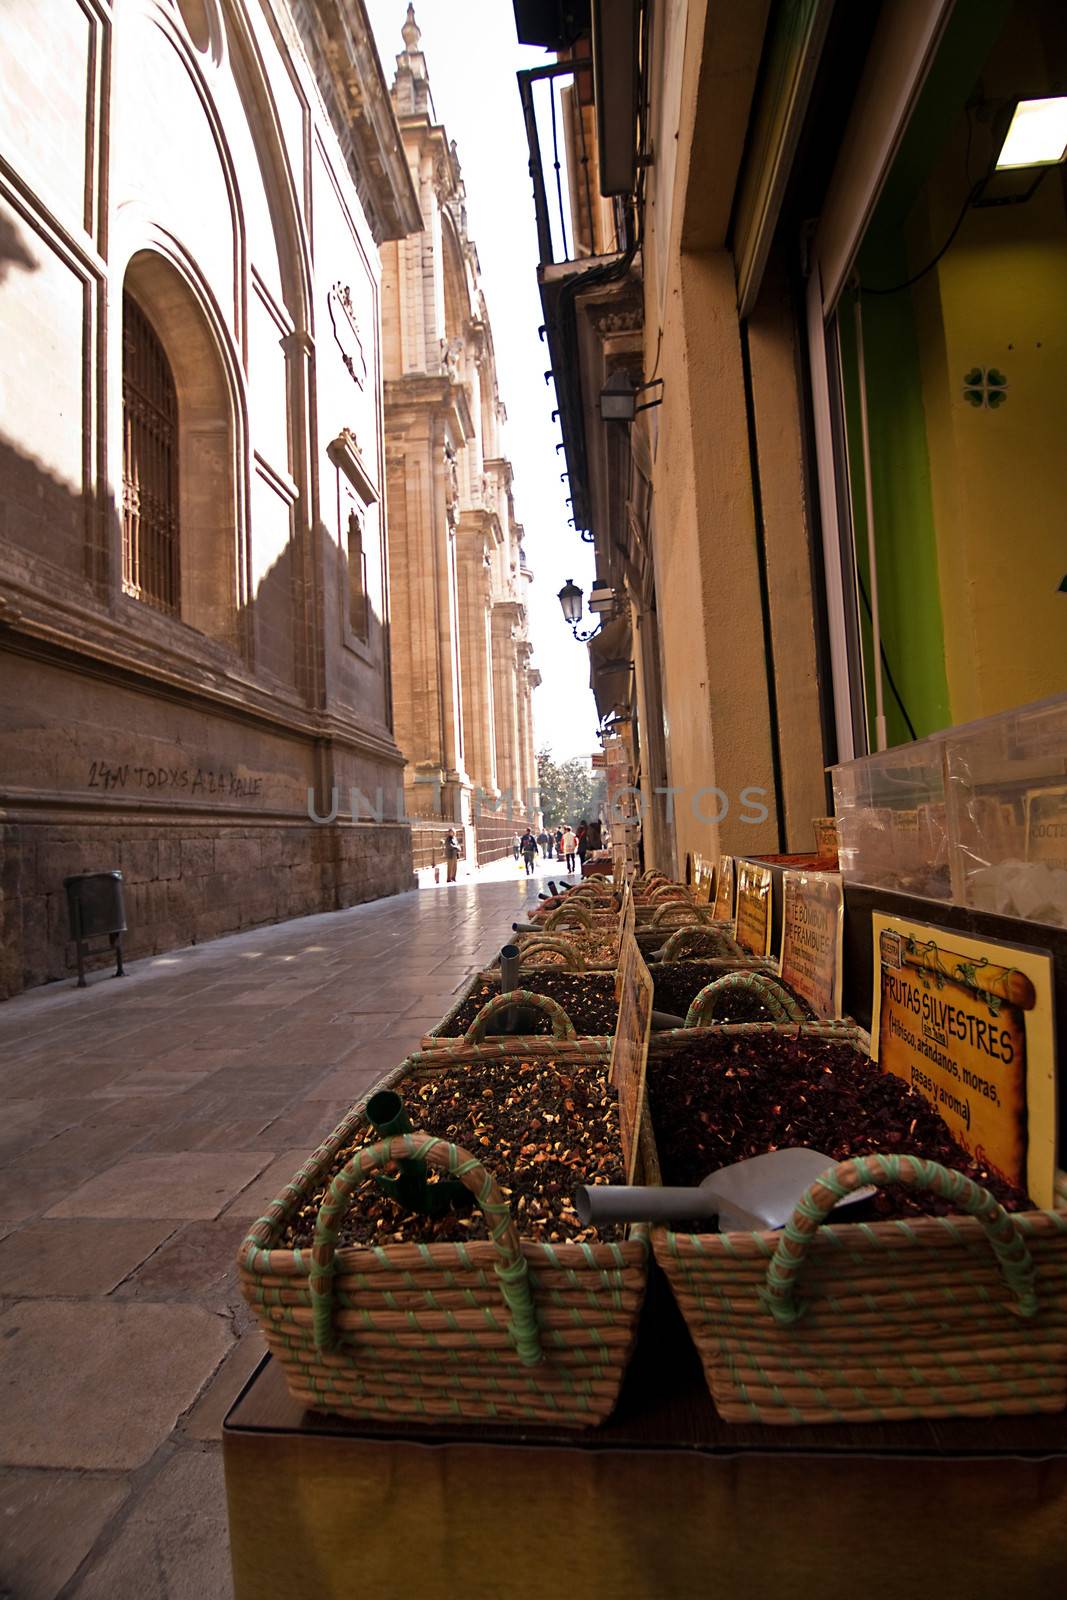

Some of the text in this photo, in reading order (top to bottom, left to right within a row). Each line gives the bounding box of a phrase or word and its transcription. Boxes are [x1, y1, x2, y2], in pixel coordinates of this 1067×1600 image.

[885, 974, 921, 1014] FRUTAS
[922, 993, 1014, 1064] SILVESTRES
[911, 1065, 932, 1092] pasas
[939, 1087, 970, 1131] aroma)
[962, 1067, 1000, 1107] moras,
